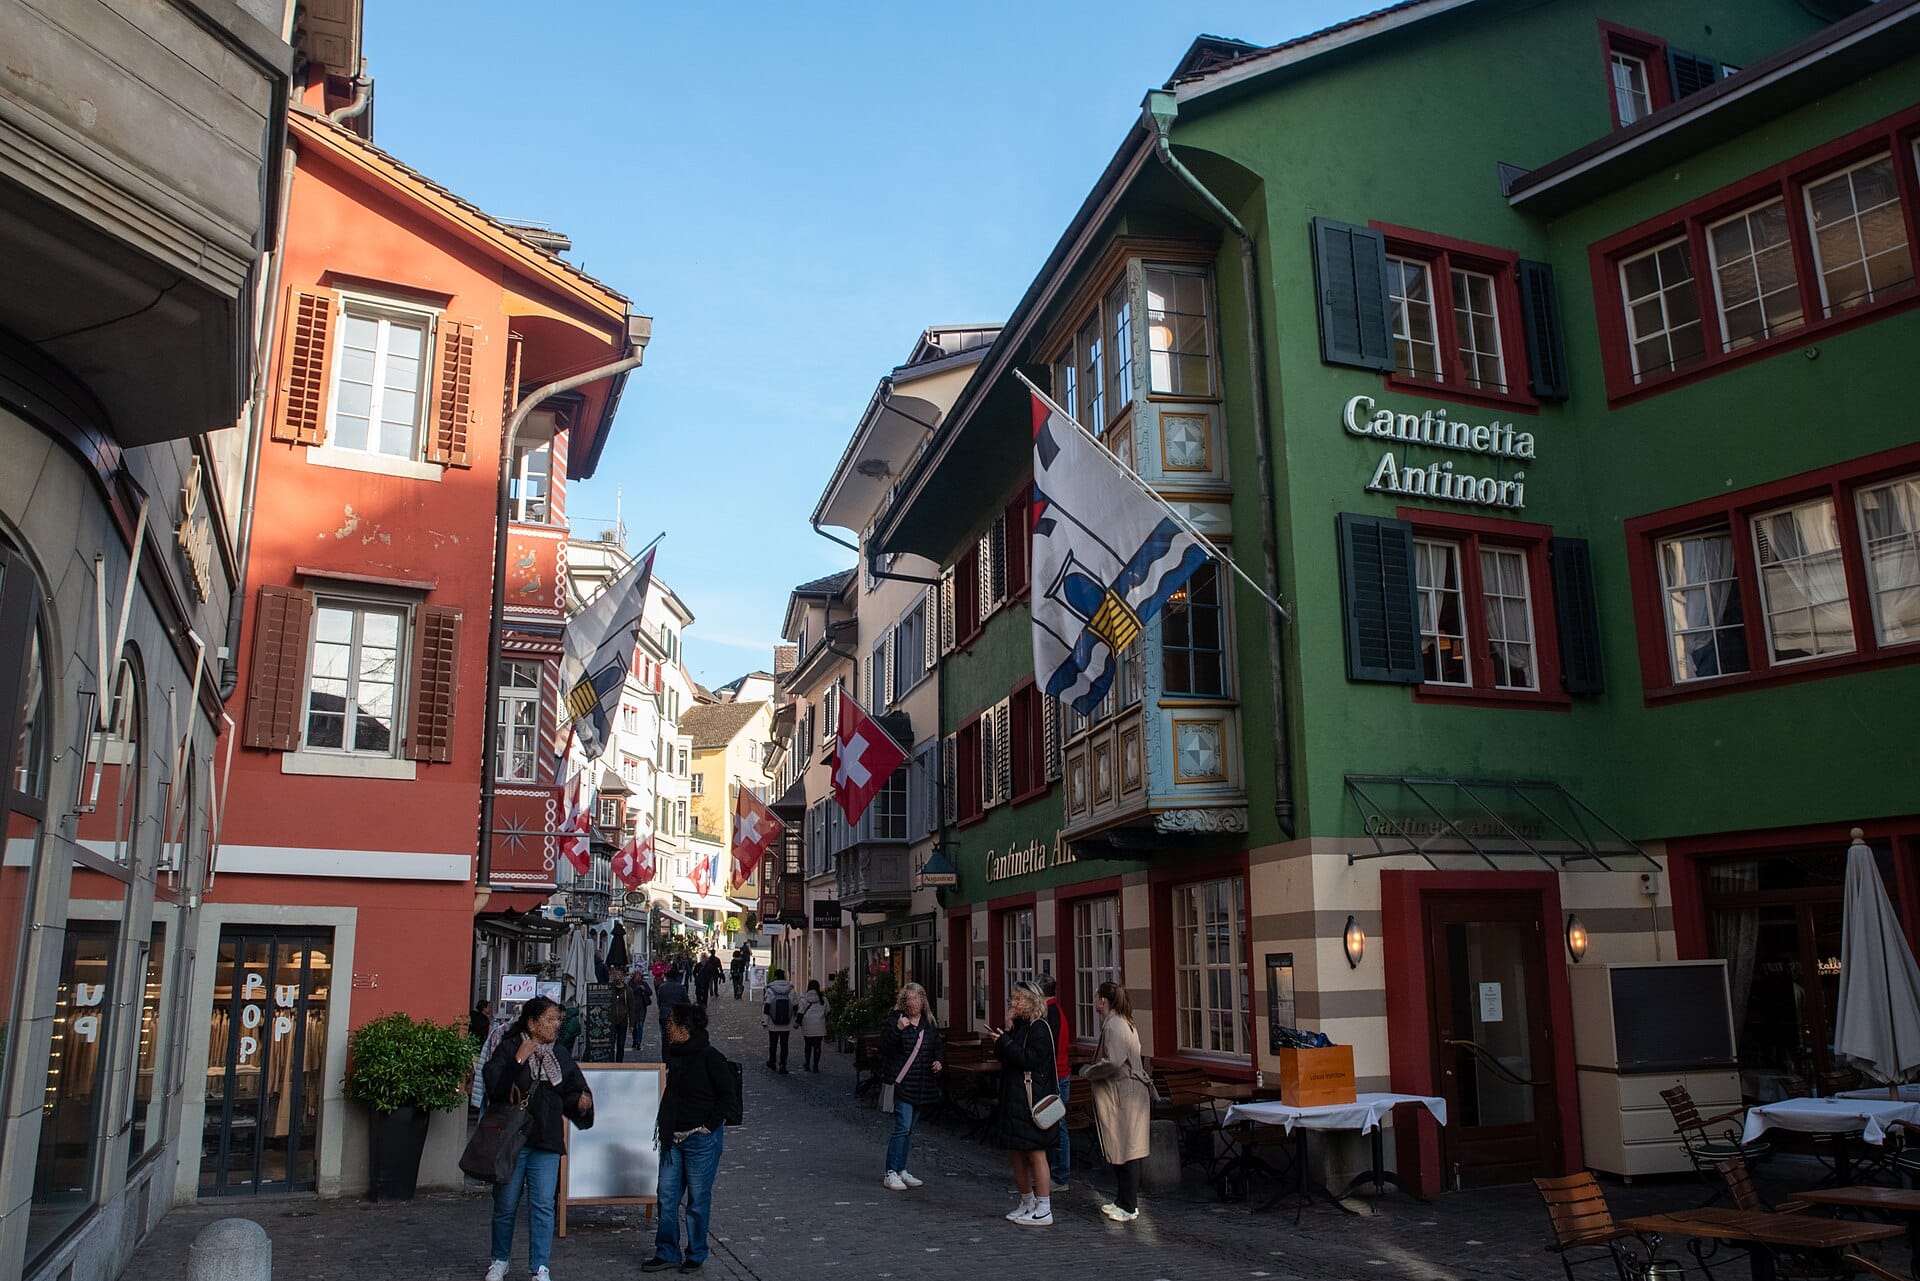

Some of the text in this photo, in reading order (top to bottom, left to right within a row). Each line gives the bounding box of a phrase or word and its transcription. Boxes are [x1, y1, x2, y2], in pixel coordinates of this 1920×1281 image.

[1343, 394, 1536, 460] Cantinetta
[1365, 452, 1526, 508] Antinori
[985, 837, 1047, 883] Cantinetta
[504, 979, 533, 997] 50%
